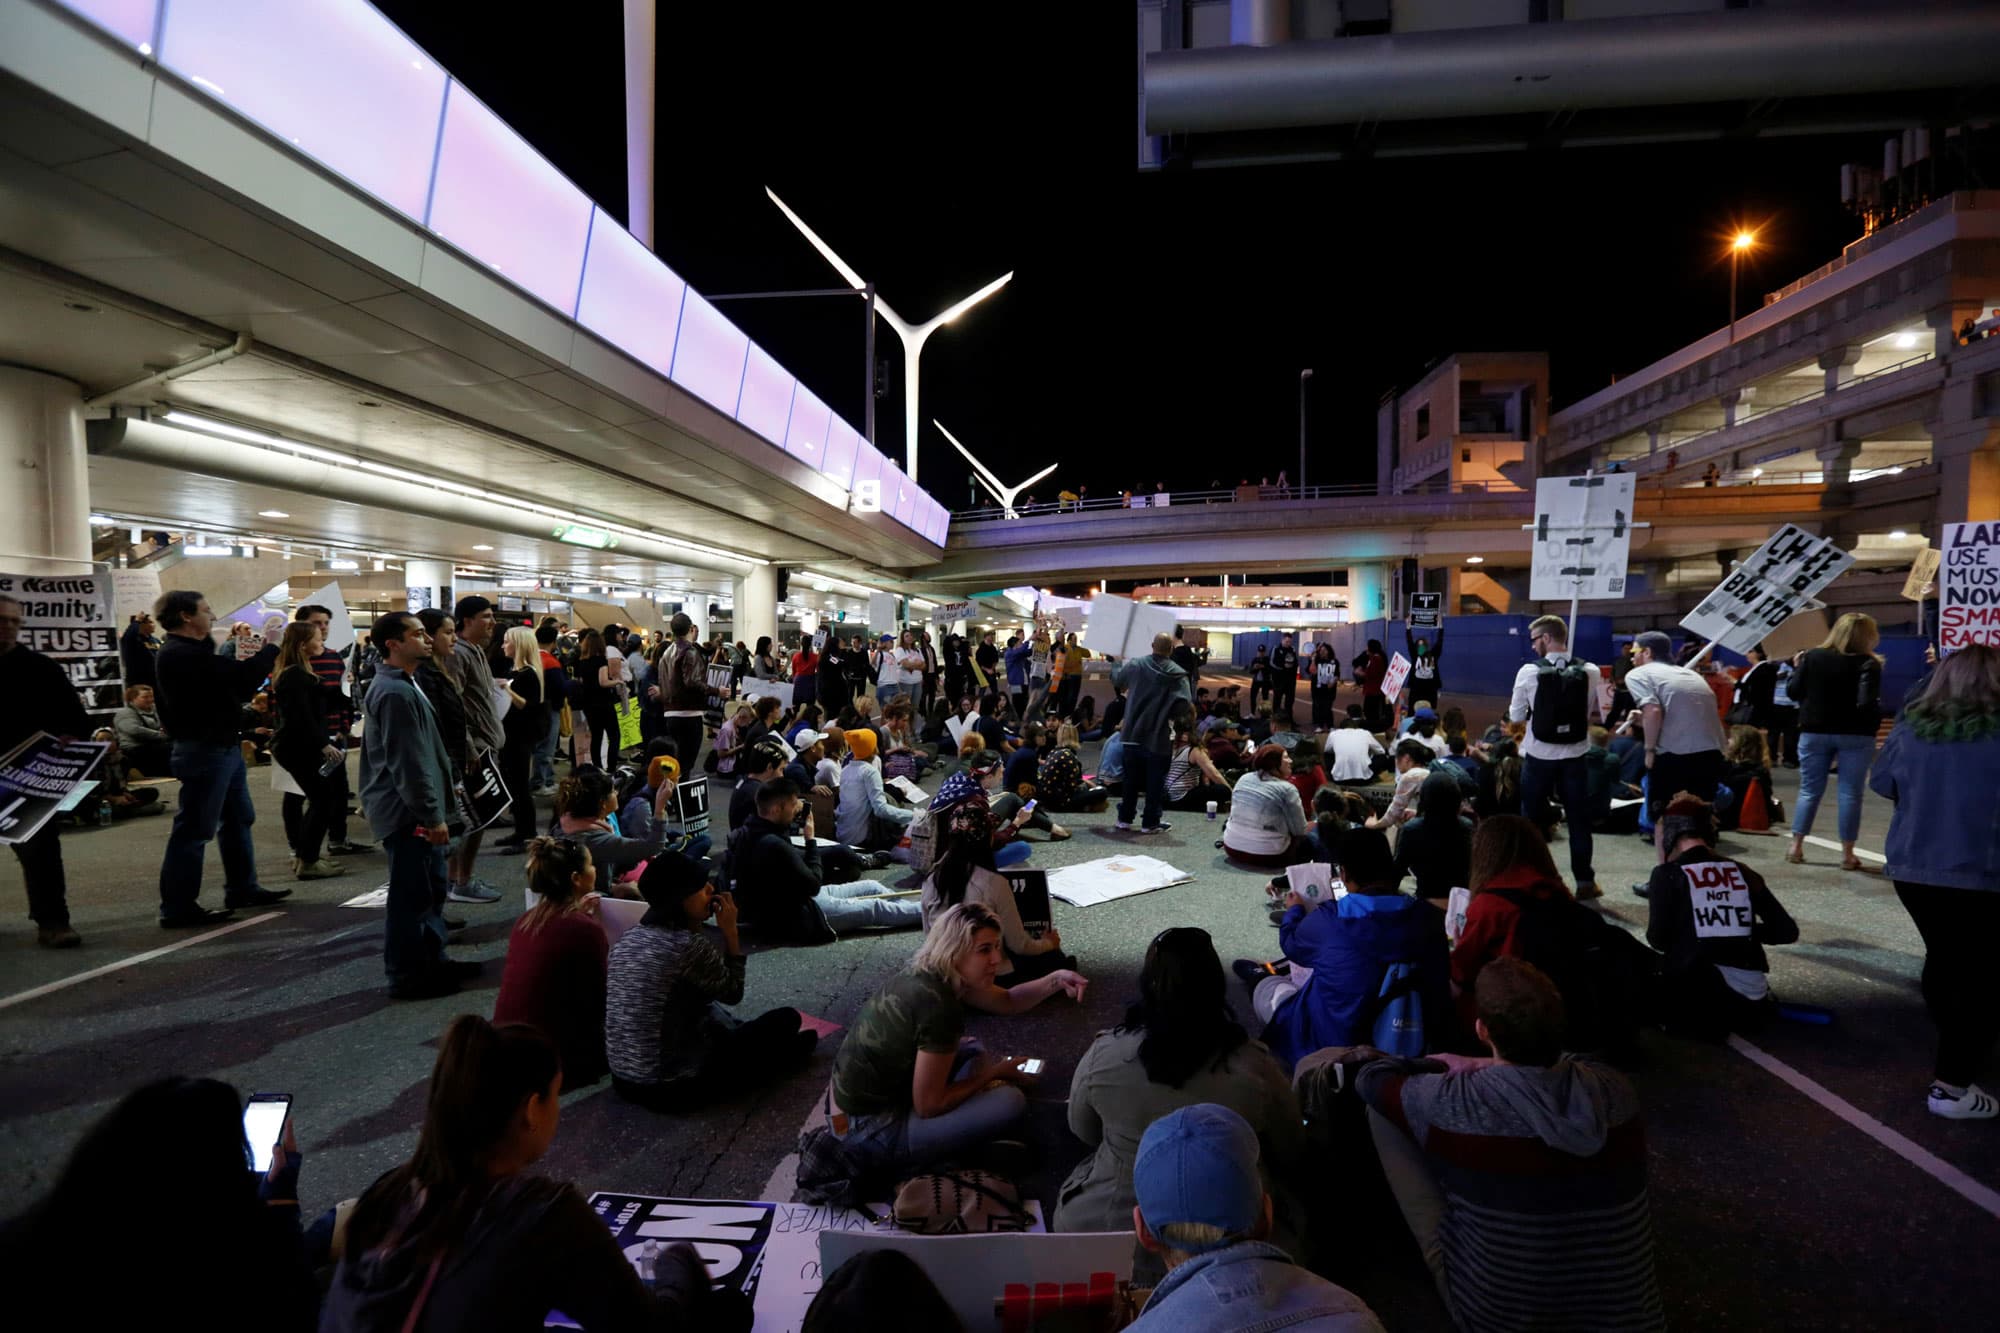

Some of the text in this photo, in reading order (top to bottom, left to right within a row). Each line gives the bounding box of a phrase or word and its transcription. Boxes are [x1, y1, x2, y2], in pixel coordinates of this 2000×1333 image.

[1947, 548, 1990, 566] USE
[21, 578, 95, 594] Name
[1685, 866, 1746, 890] LOVE
[1706, 890, 1730, 901] NOT
[1695, 905, 1751, 927] HATE
[615, 1202, 642, 1225] STOP
[775, 1204, 866, 1233] MATTER
